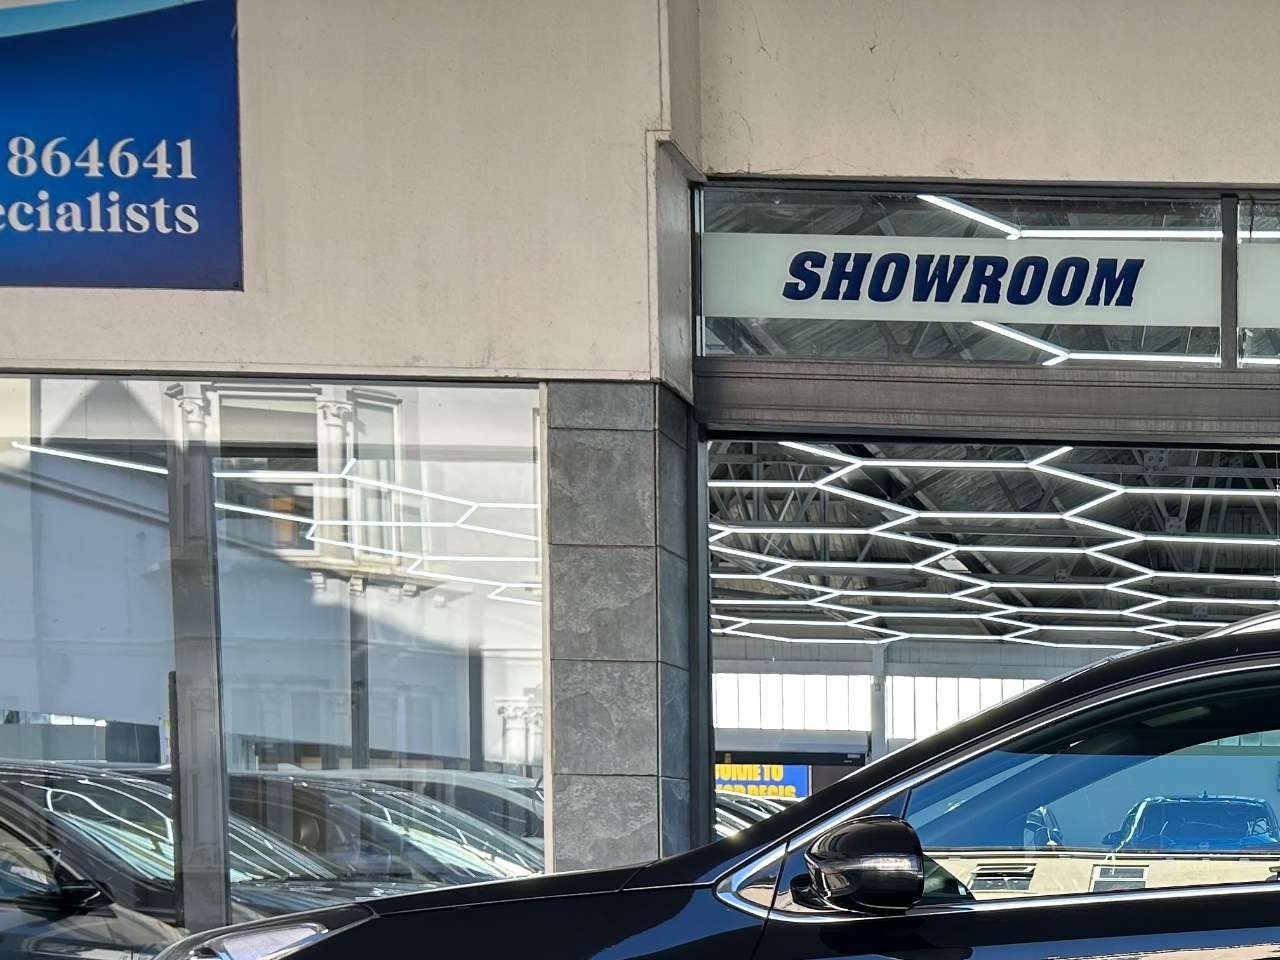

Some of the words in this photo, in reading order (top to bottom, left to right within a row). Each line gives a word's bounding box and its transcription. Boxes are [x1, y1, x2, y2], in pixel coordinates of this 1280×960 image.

[7, 136, 197, 179] 864641
[0, 189, 200, 234] cialists
[782, 250, 1145, 307] SHOWROOM
[715, 764, 761, 781] OME
